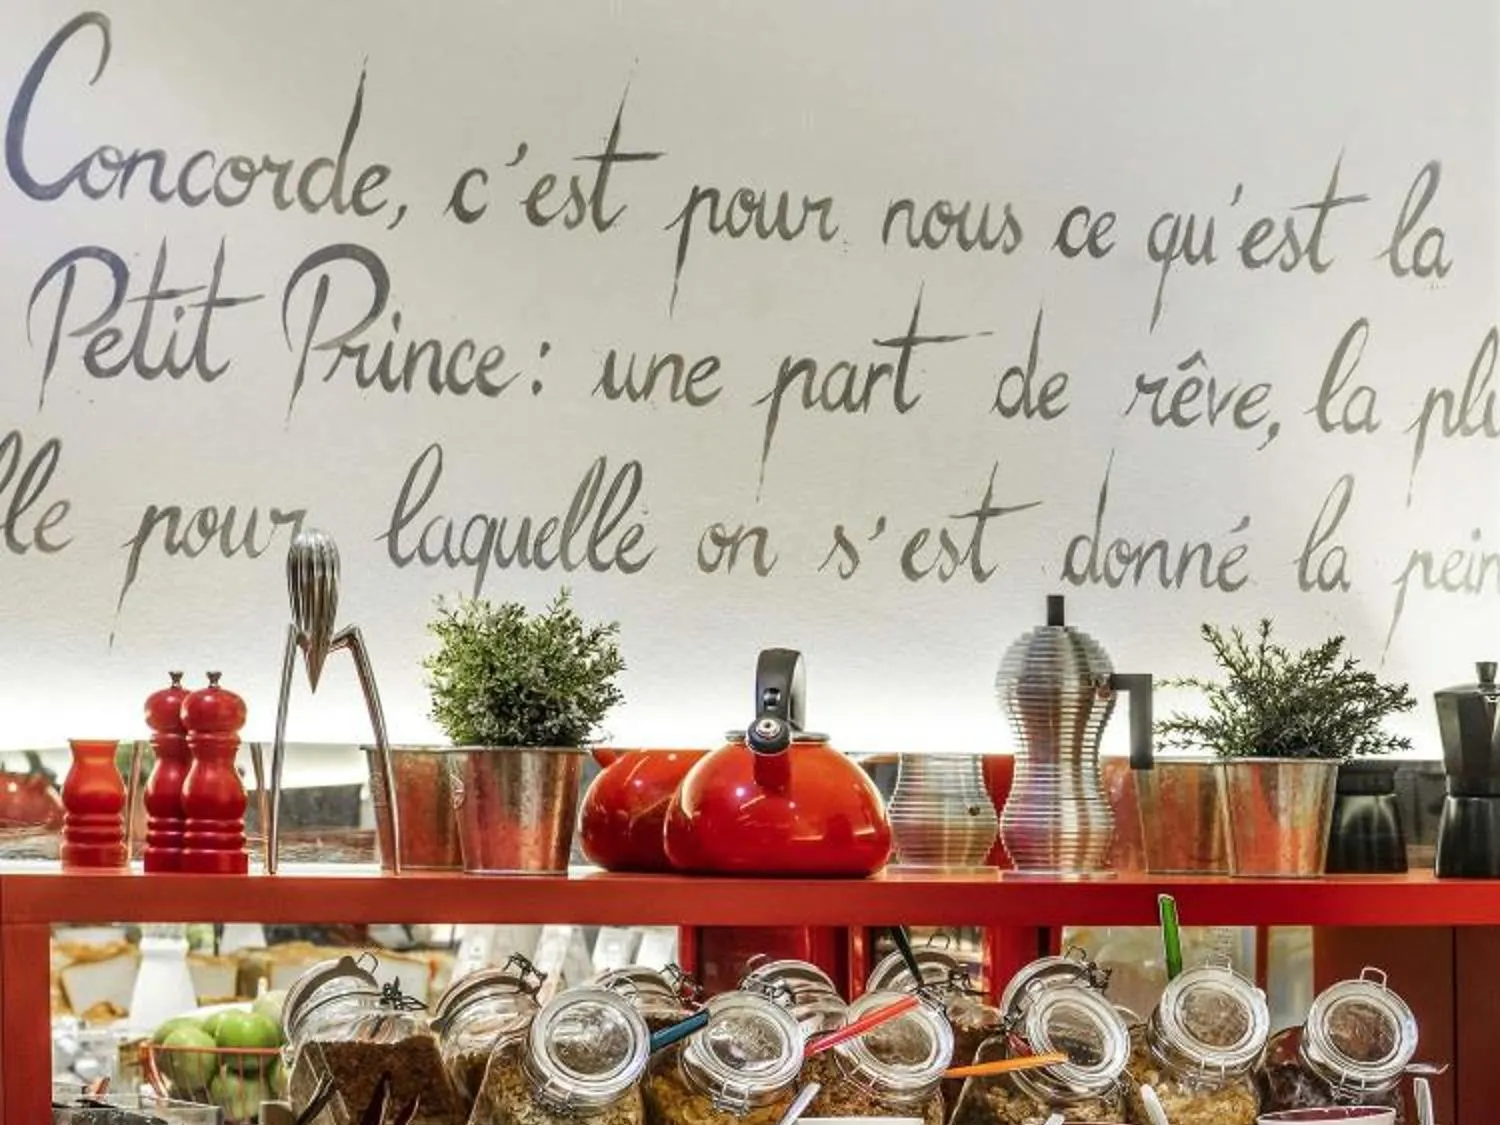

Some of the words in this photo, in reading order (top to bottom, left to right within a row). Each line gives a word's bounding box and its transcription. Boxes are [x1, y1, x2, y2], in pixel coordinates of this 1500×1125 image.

[4, 10, 408, 230] Concorde,
[443, 57, 666, 232] c'est
[665, 178, 841, 319] pour
[880, 196, 1024, 256] nous
[1053, 203, 1116, 259] ce
[1146, 146, 1370, 334] qu'est
[1378, 158, 1454, 279] la
[26, 236, 265, 410] Petit
[592, 345, 725, 408] une
[752, 281, 993, 503] part
[992, 298, 1071, 420] de
[1125, 349, 1281, 451] rêve,
[1304, 316, 1382, 434] la
[109, 502, 307, 648] pour
[375, 442, 658, 600] laquelle
[696, 521, 780, 578] on
[816, 460, 1043, 584] s'est
[1060, 448, 1252, 594] donné
[1294, 473, 1352, 594] la
